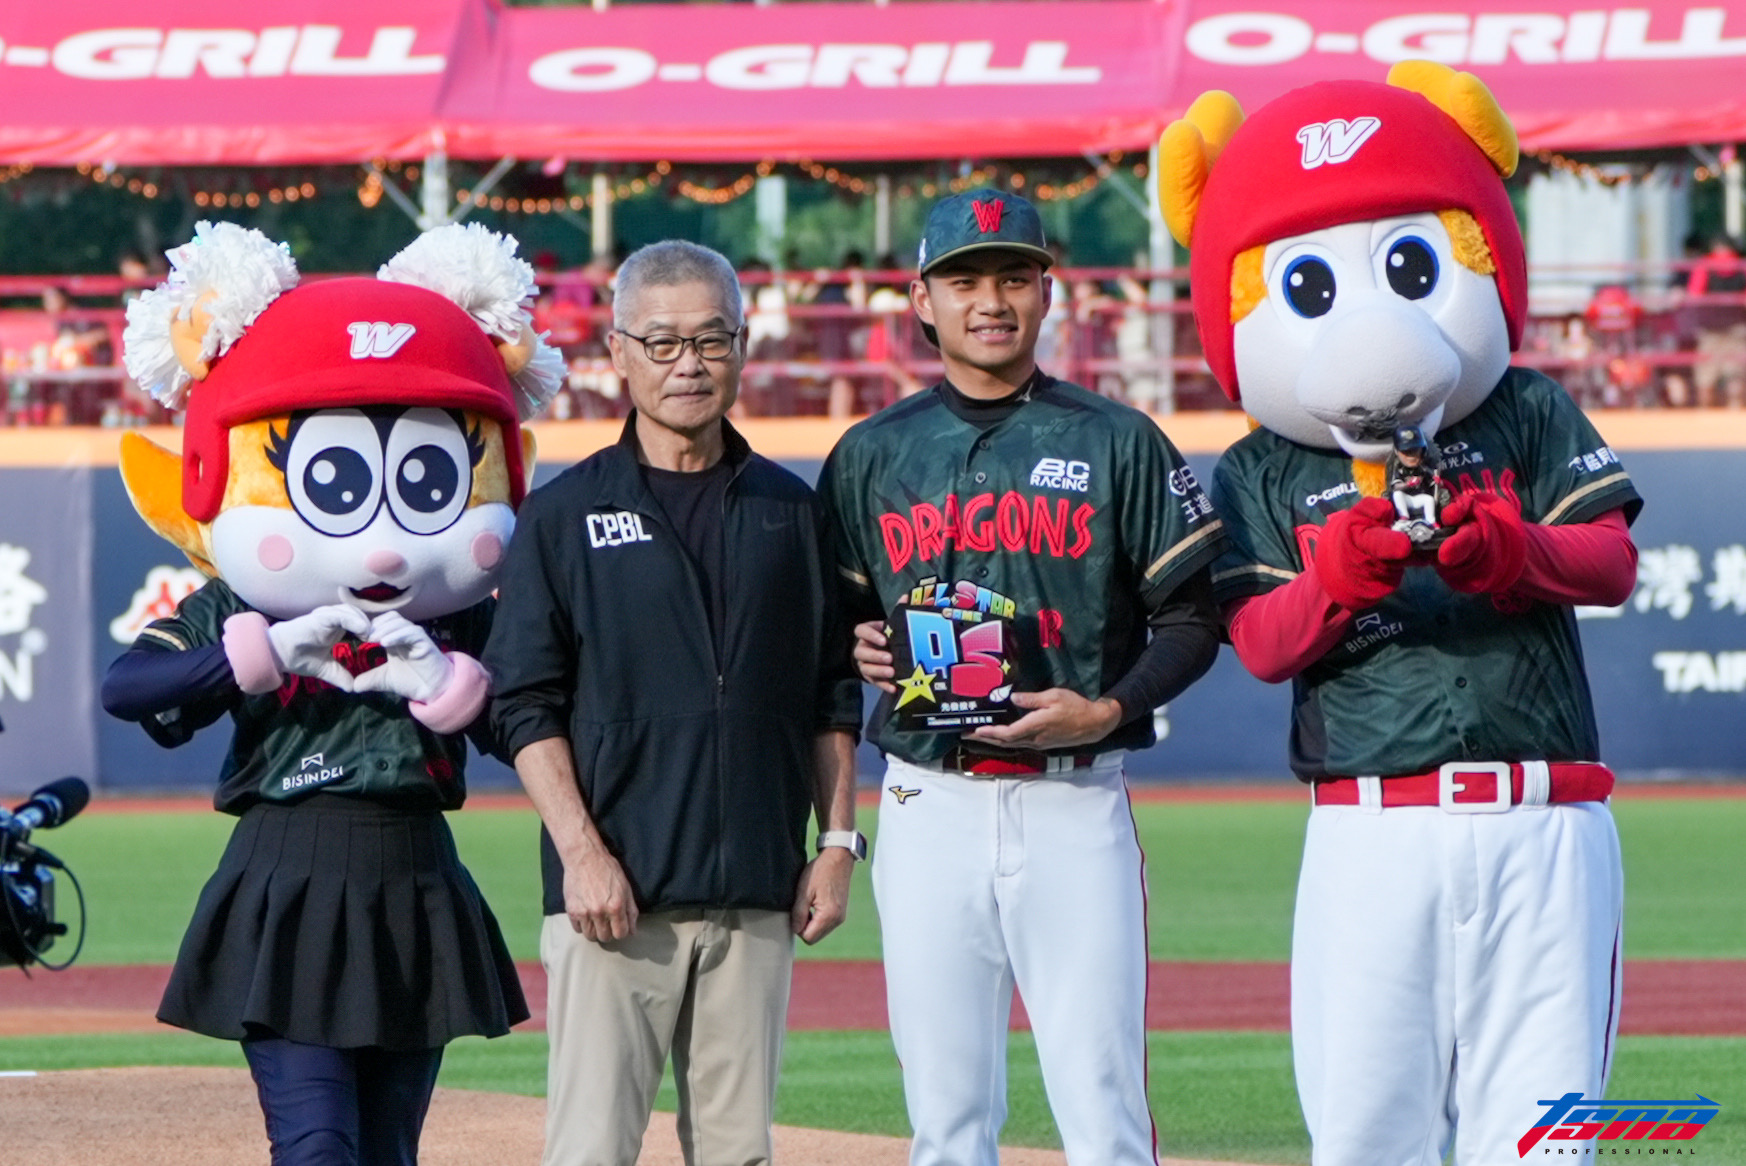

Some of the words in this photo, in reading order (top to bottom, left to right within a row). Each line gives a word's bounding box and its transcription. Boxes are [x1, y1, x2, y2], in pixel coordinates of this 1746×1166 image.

[0, 25, 446, 79] -GRILL
[1185, 8, 1746, 66] O-GRILL
[528, 40, 1102, 92] O-GRILL
[1296, 116, 1381, 170] W
[971, 199, 1005, 233] W
[347, 321, 417, 359] W
[1029, 473, 1088, 492] RACING
[1031, 457, 1090, 480] BC
[1305, 482, 1359, 507] O-GRILL
[586, 510, 653, 548] CPBL
[879, 490, 1096, 573] DRAGONS
[282, 765, 343, 791] BISINDEI
